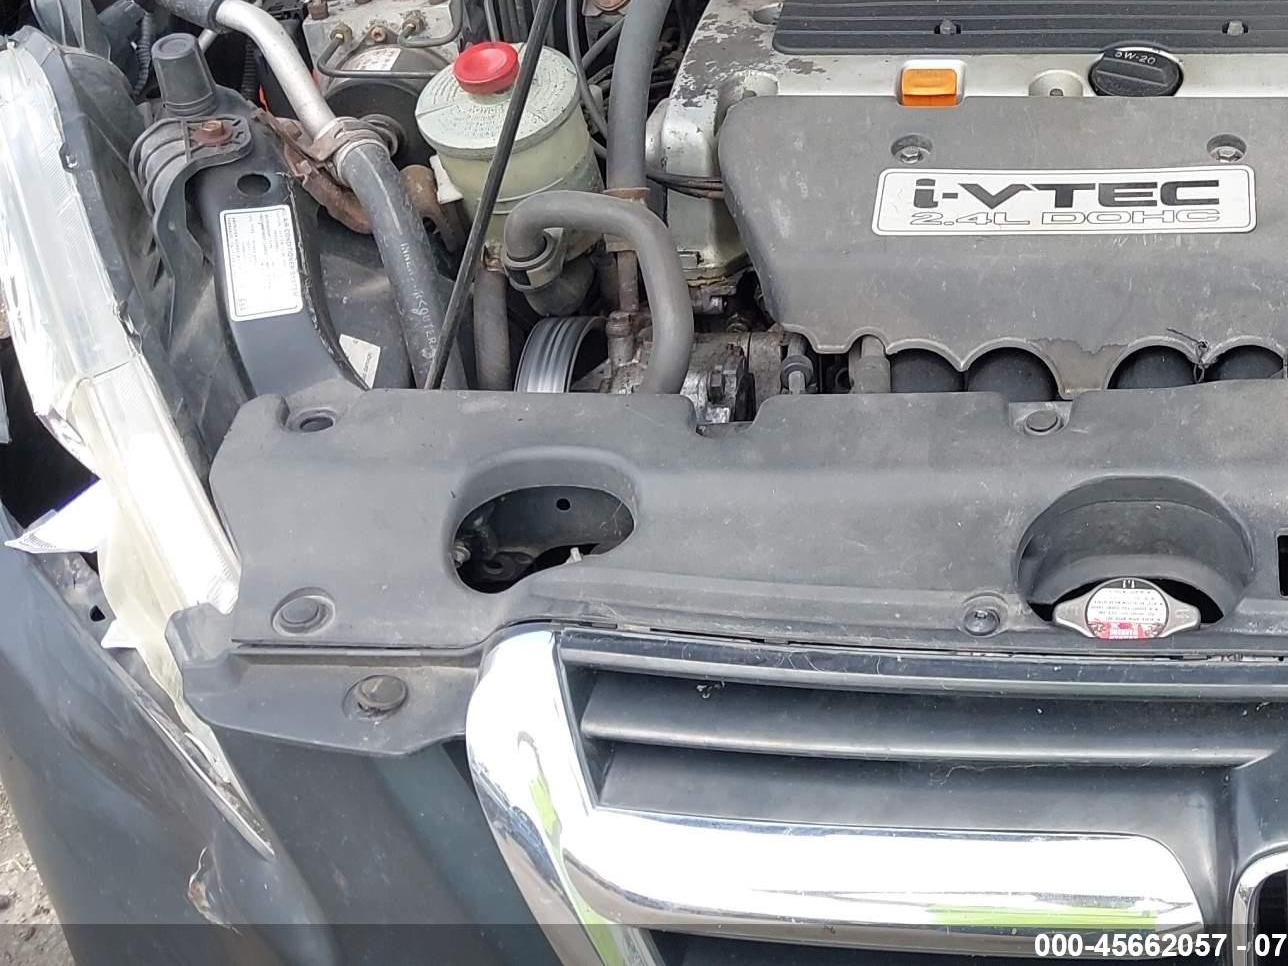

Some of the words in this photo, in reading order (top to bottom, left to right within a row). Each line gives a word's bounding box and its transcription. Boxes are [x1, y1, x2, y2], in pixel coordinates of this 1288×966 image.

[913, 177, 1220, 210] i-VTEC
[910, 210, 1031, 226] 2.4L
[1041, 208, 1221, 226] DOHC
